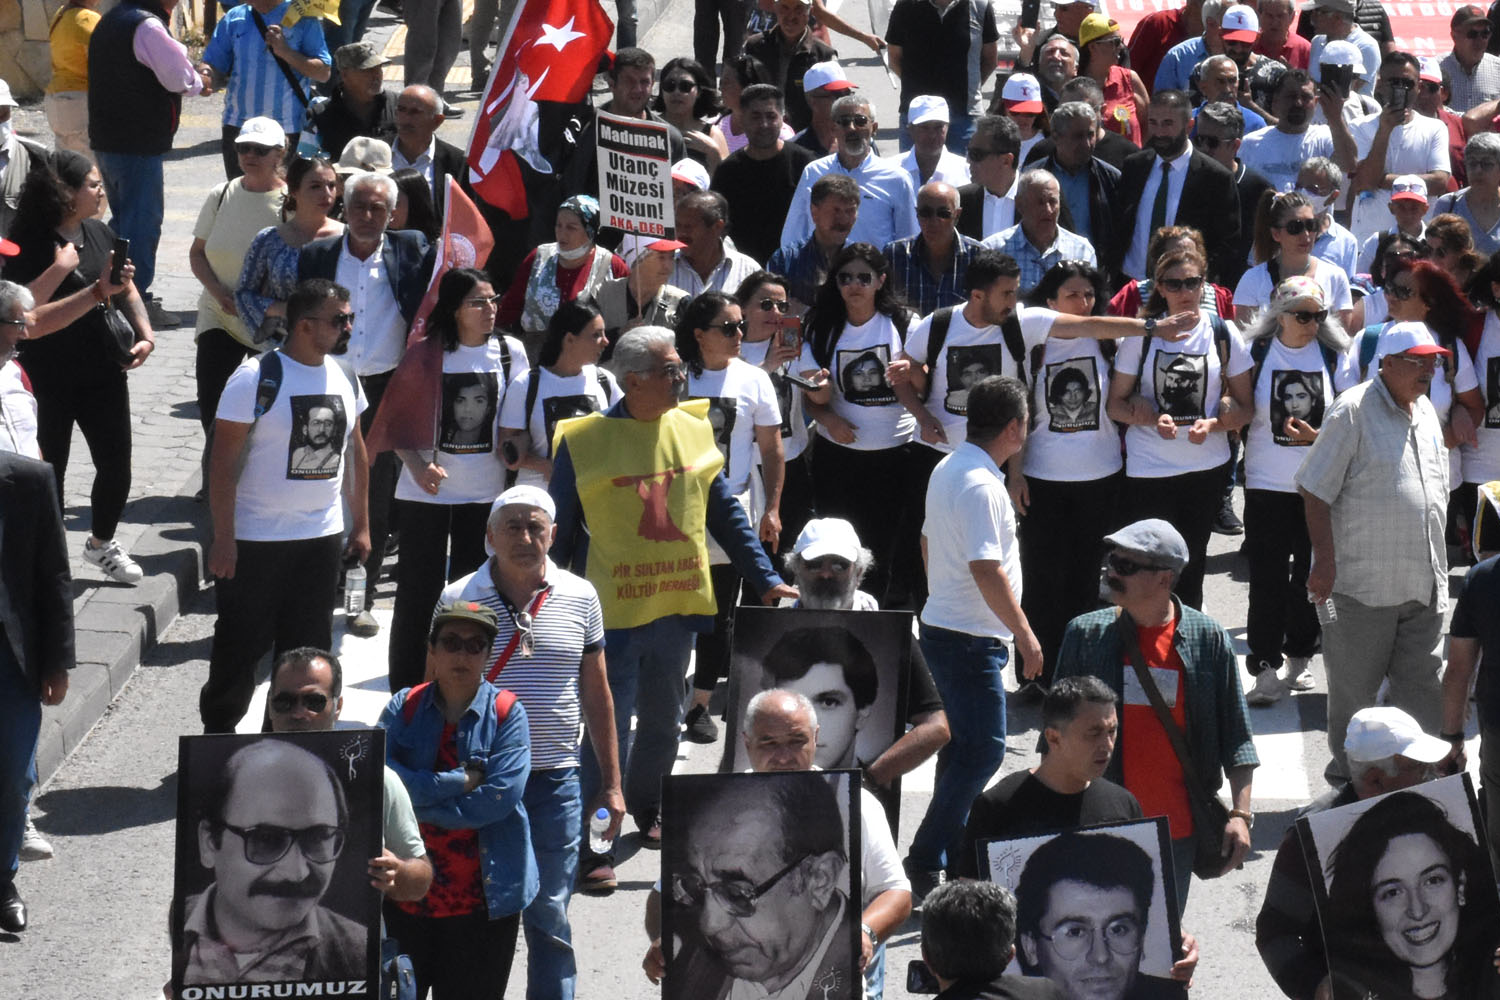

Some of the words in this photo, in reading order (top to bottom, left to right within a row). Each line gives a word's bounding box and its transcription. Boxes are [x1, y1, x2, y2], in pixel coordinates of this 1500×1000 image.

[599, 123, 666, 151] Madımak
[608, 151, 659, 180] Utanç
[605, 171, 665, 200] Müzesi
[609, 193, 664, 220] Olsun!
[609, 214, 665, 236] AKA-DER
[181, 980, 368, 1000] ONURUMUZ
